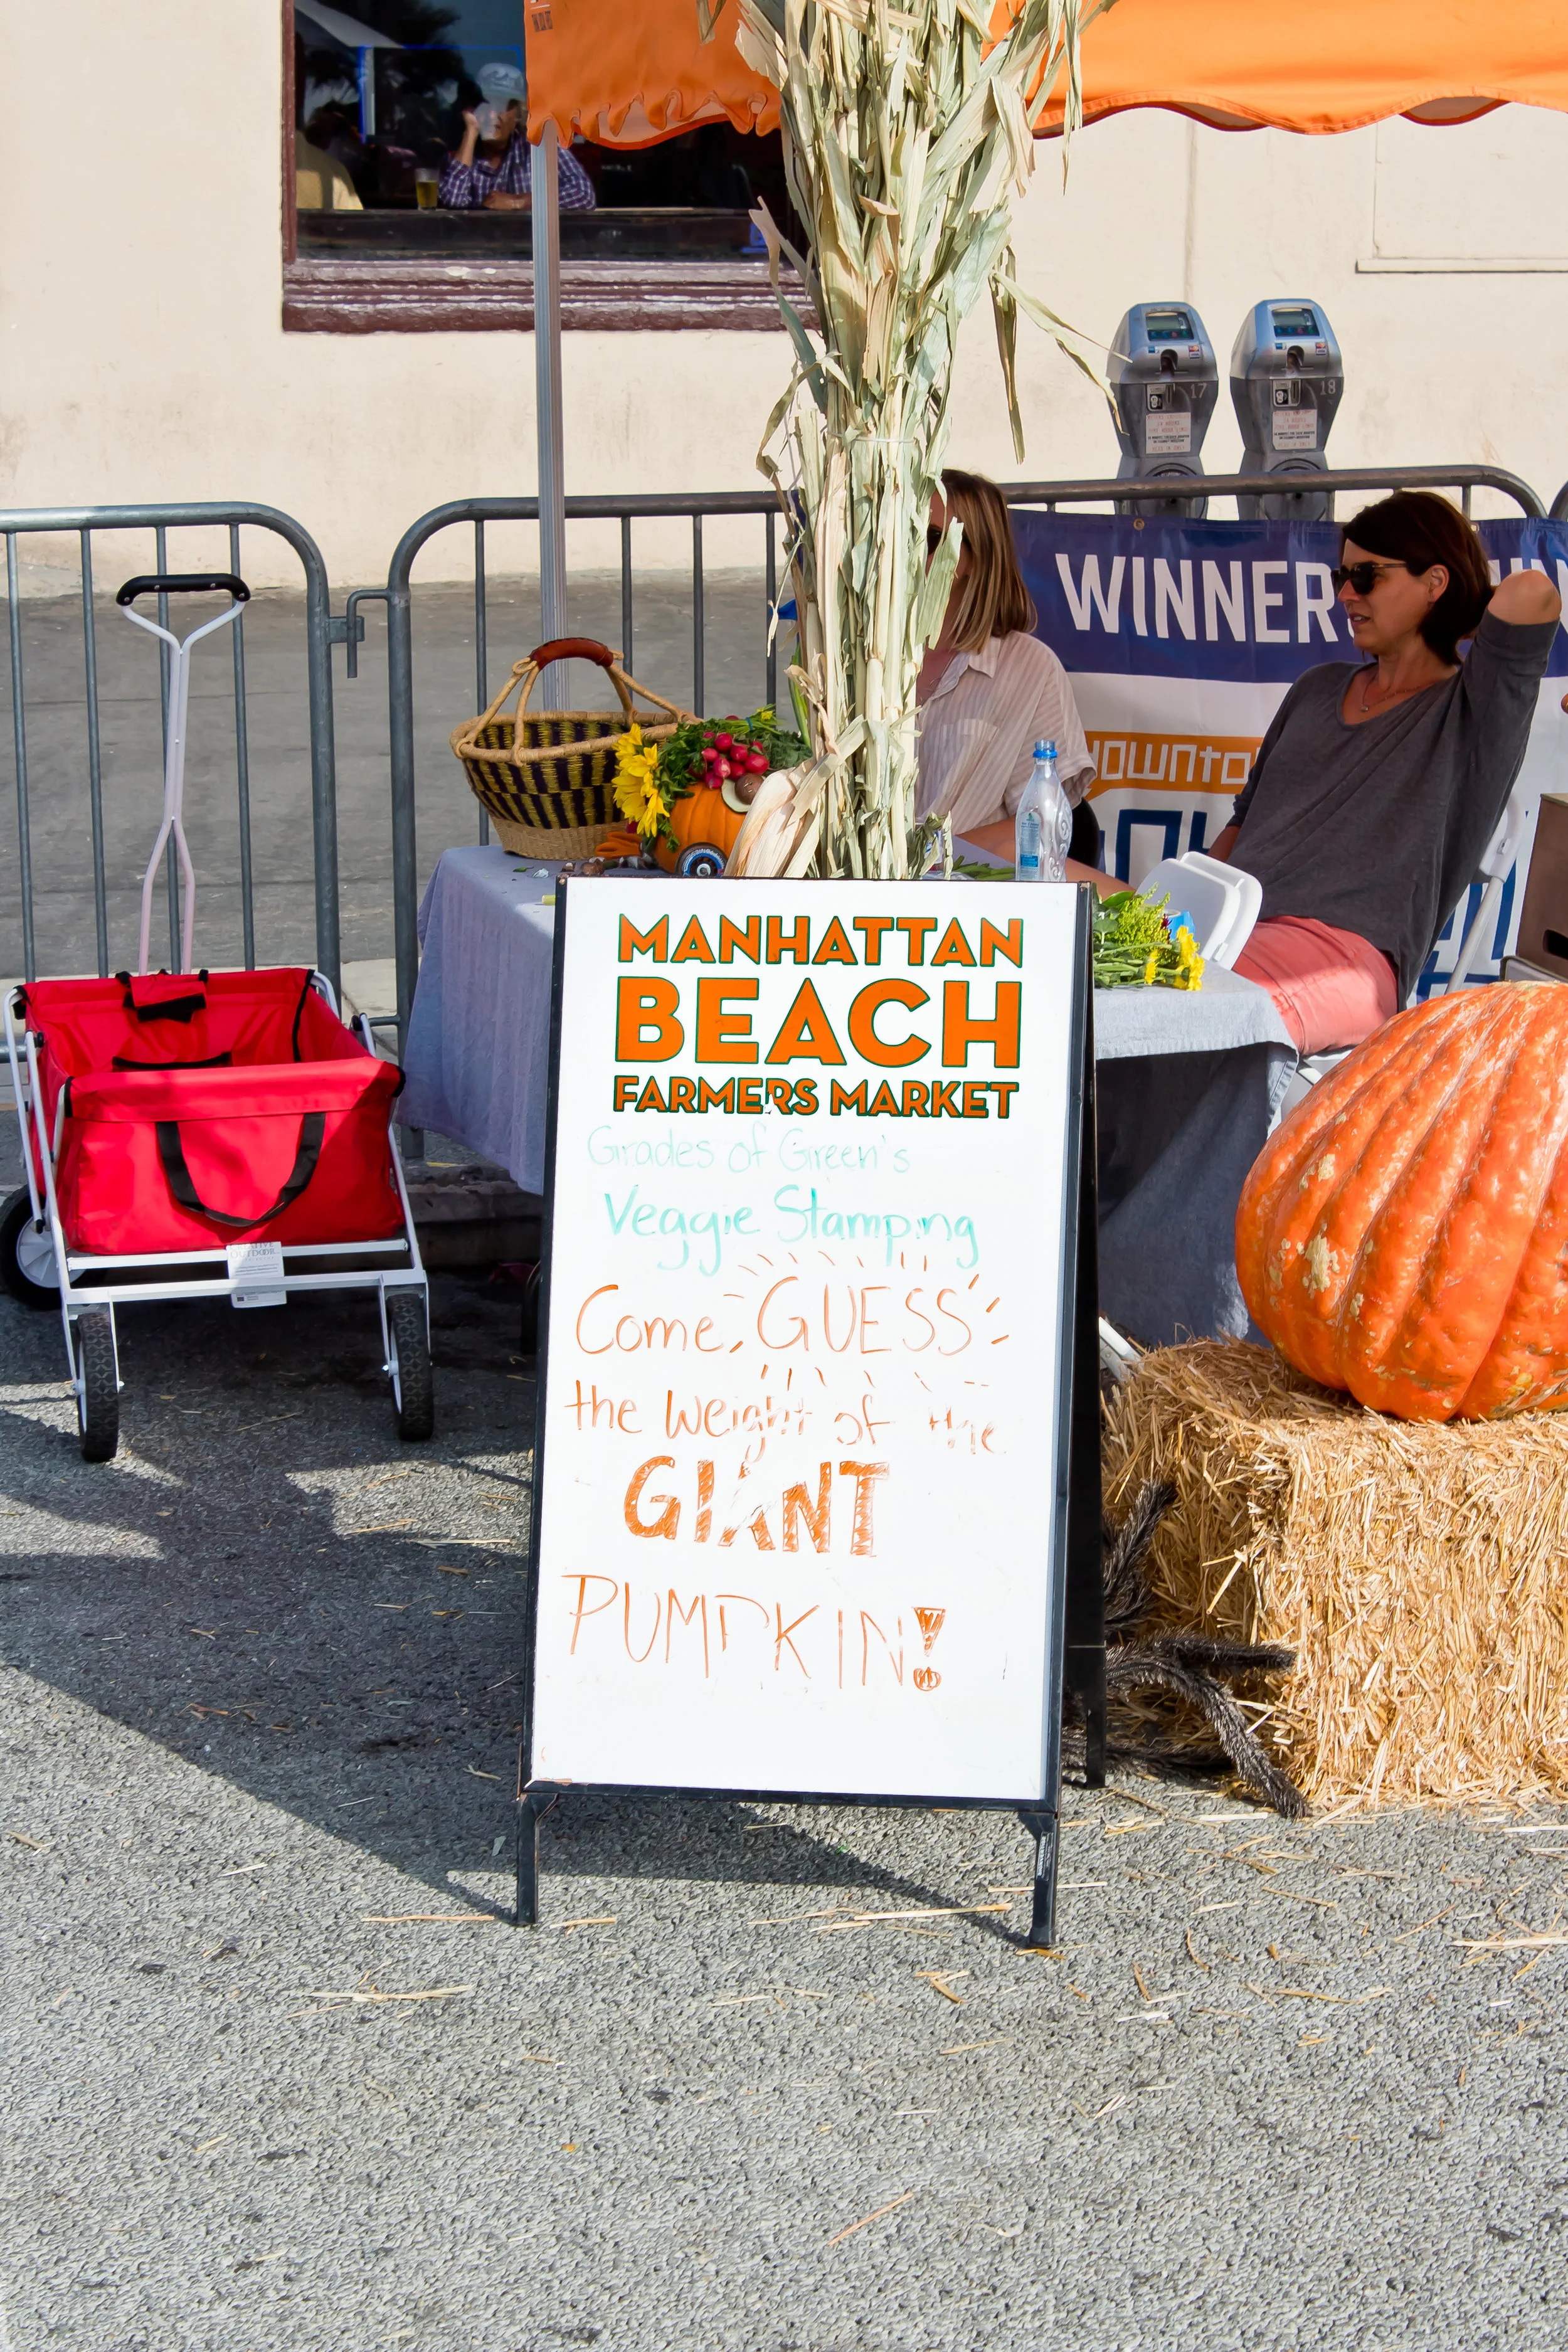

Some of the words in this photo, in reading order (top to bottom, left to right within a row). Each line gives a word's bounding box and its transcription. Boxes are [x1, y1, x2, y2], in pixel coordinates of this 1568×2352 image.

[1190, 382, 1207, 399] 17
[1320, 378, 1337, 395] 18
[1056, 553, 1355, 644] WINNER
[1091, 740, 1261, 785] ownto
[618, 913, 1024, 968] MANHATTAN
[615, 976, 1023, 1069] BEACH
[613, 1075, 820, 1116] FARMERS
[830, 1079, 1020, 1120] MARKET
[588, 1125, 714, 1168] Grades
[728, 1121, 768, 1173] of
[780, 1128, 911, 1173] Green's
[605, 1185, 761, 1277] Veggie
[774, 1184, 979, 1270] Stamping
[576, 1285, 723, 1354] Come
[757, 1276, 972, 1356] GUESS
[564, 1379, 642, 1434] the
[835, 1394, 894, 1446] of
[623, 1455, 891, 1557] GIANT
